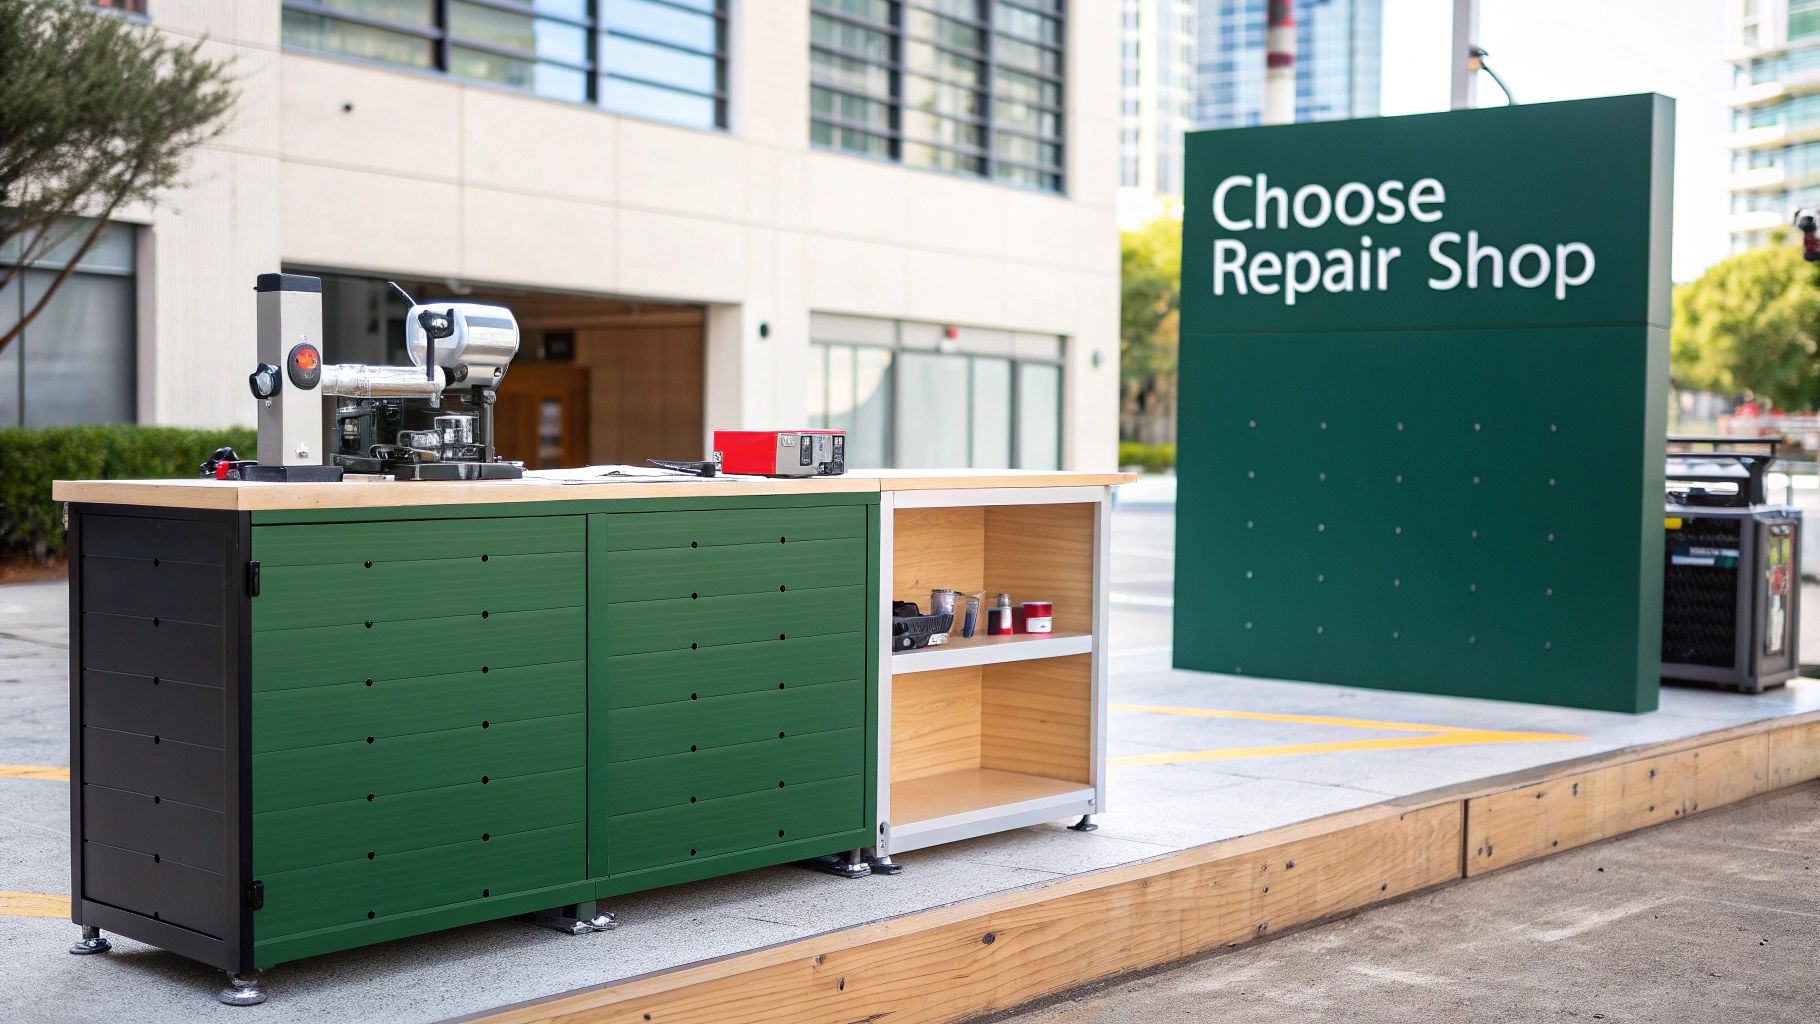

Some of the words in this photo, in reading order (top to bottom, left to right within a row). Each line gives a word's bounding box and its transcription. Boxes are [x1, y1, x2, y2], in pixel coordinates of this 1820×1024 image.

[1211, 173, 1446, 231] Choose
[1213, 235, 1401, 306] Repair
[1428, 231, 1595, 300] Shop
